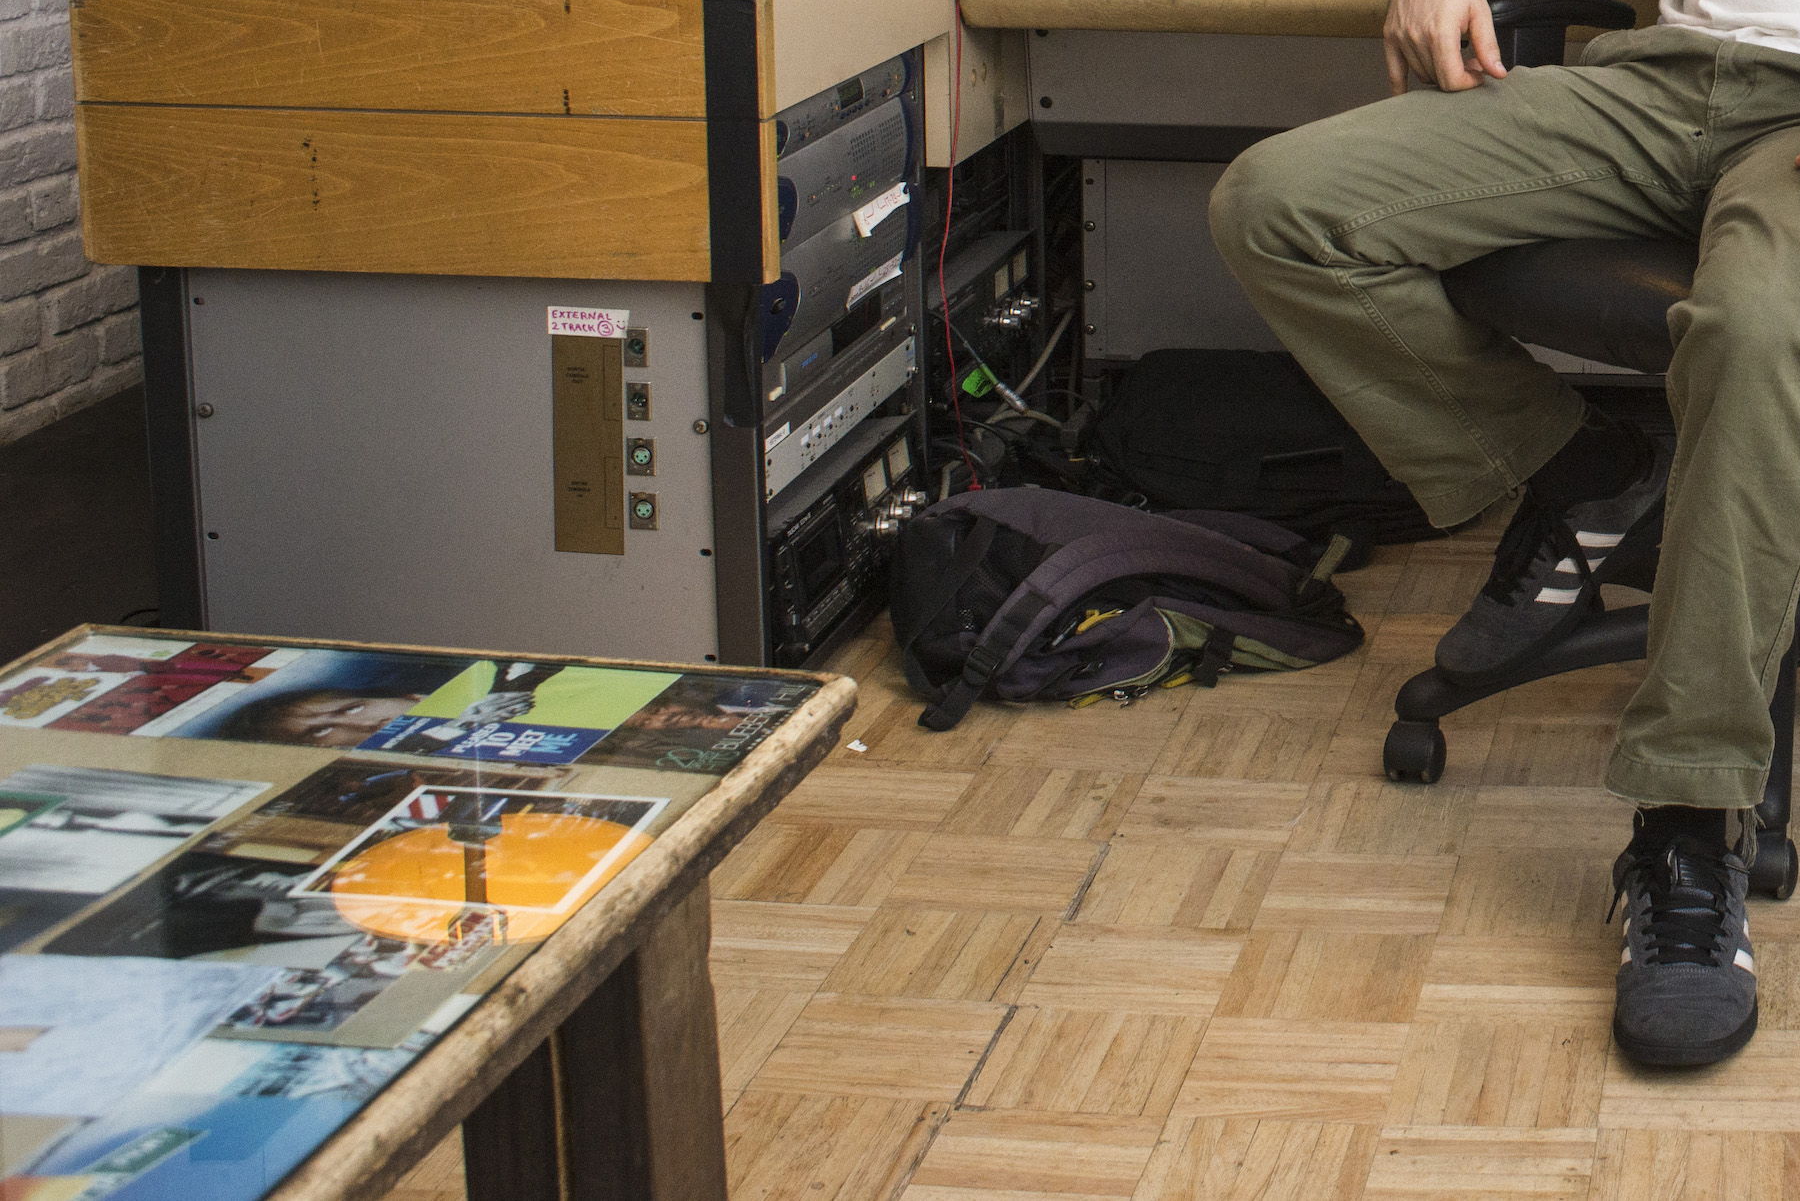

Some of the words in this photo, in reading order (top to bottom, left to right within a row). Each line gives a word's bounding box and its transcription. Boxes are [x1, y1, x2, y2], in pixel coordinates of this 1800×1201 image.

[551, 309, 613, 321] EXTERNAL
[551, 321, 560, 331] 2
[561, 322, 597, 333] TRACK
[450, 722, 502, 754] PLEASED
[474, 731, 517, 748] TO
[498, 728, 548, 758] MEET
[527, 731, 580, 755] ME
